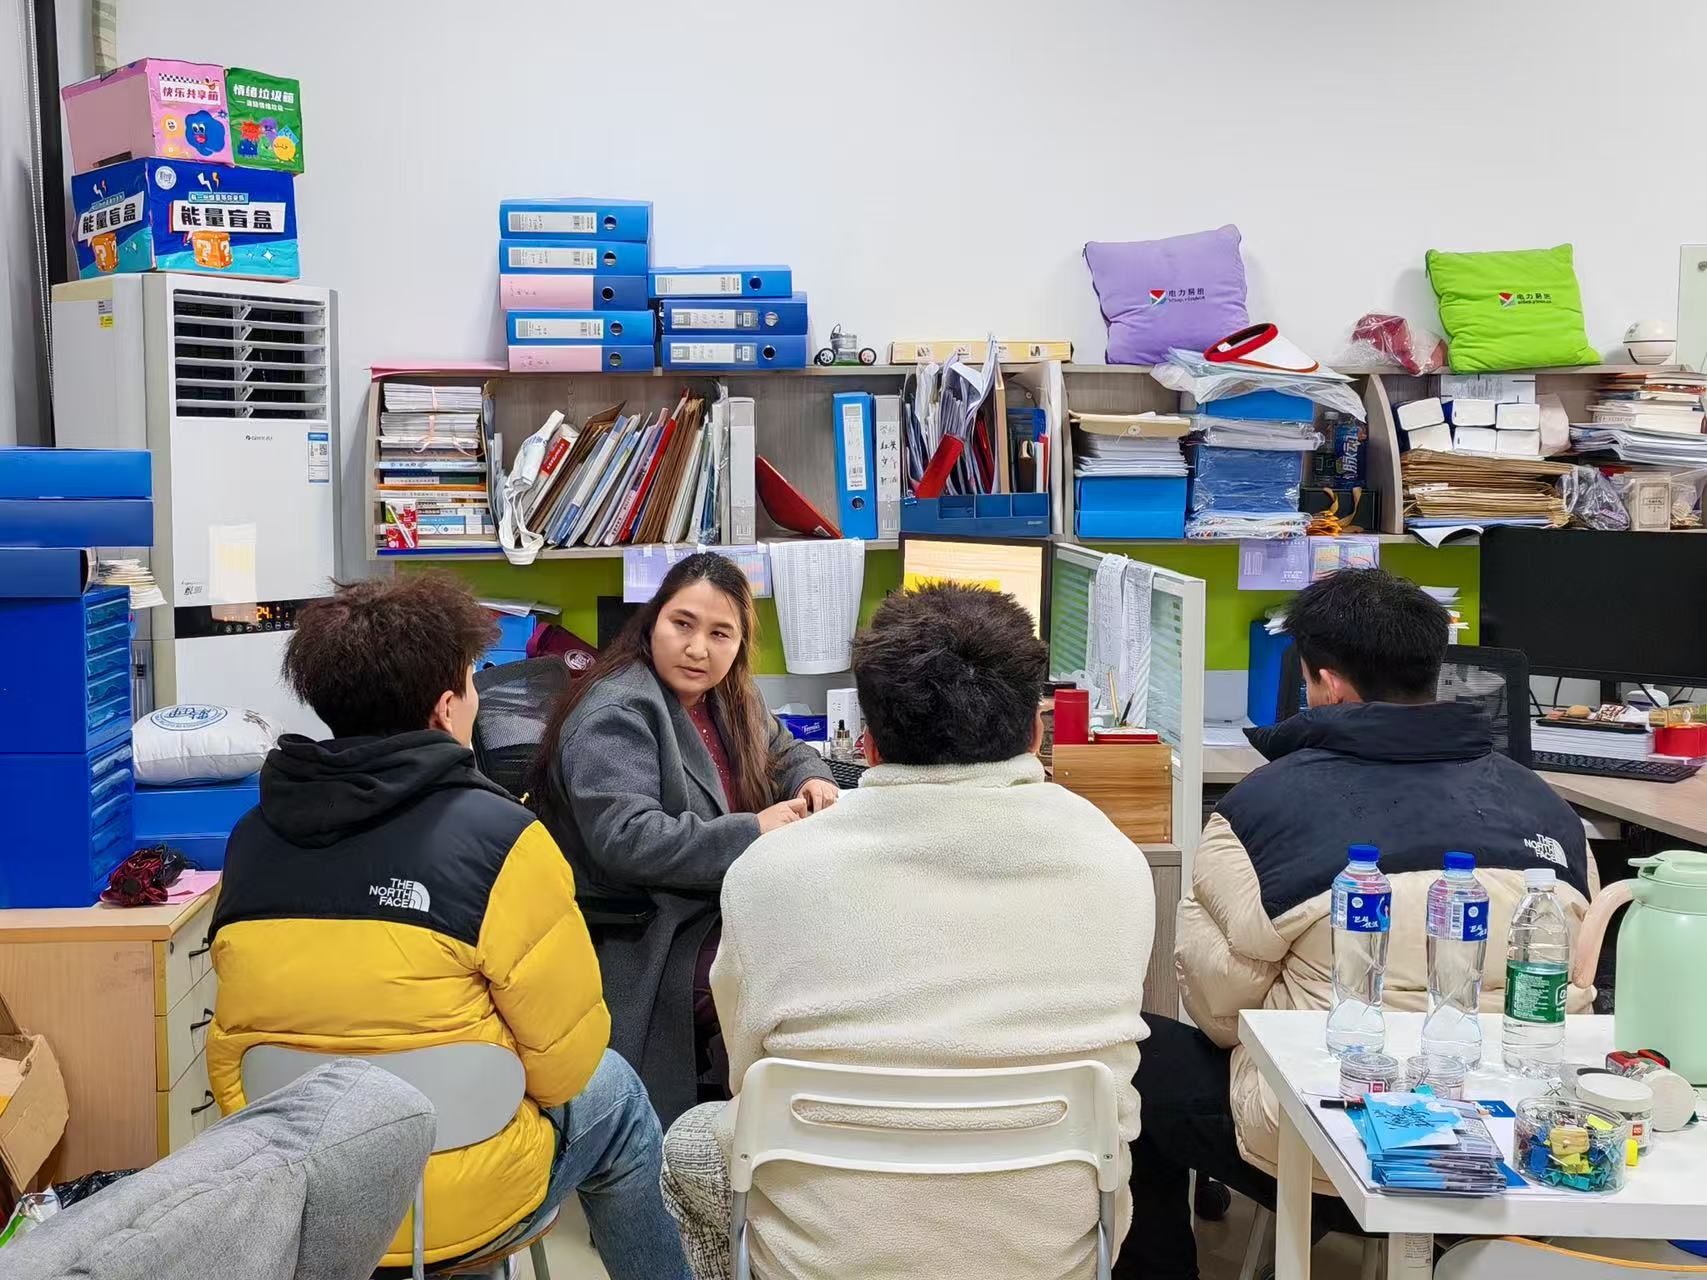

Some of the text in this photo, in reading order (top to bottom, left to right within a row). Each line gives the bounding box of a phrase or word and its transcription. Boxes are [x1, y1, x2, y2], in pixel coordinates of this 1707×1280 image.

[163, 86, 219, 101] 快乐共享箱
[233, 83, 295, 104] 情绪垃圾箱
[83, 203, 136, 234] 能量盲盒
[181, 205, 272, 229] 能量盲盒
[256, 606, 270, 620] 24
[390, 877, 414, 890] THE
[369, 885, 412, 900] NORTH
[379, 896, 410, 908] FACE
